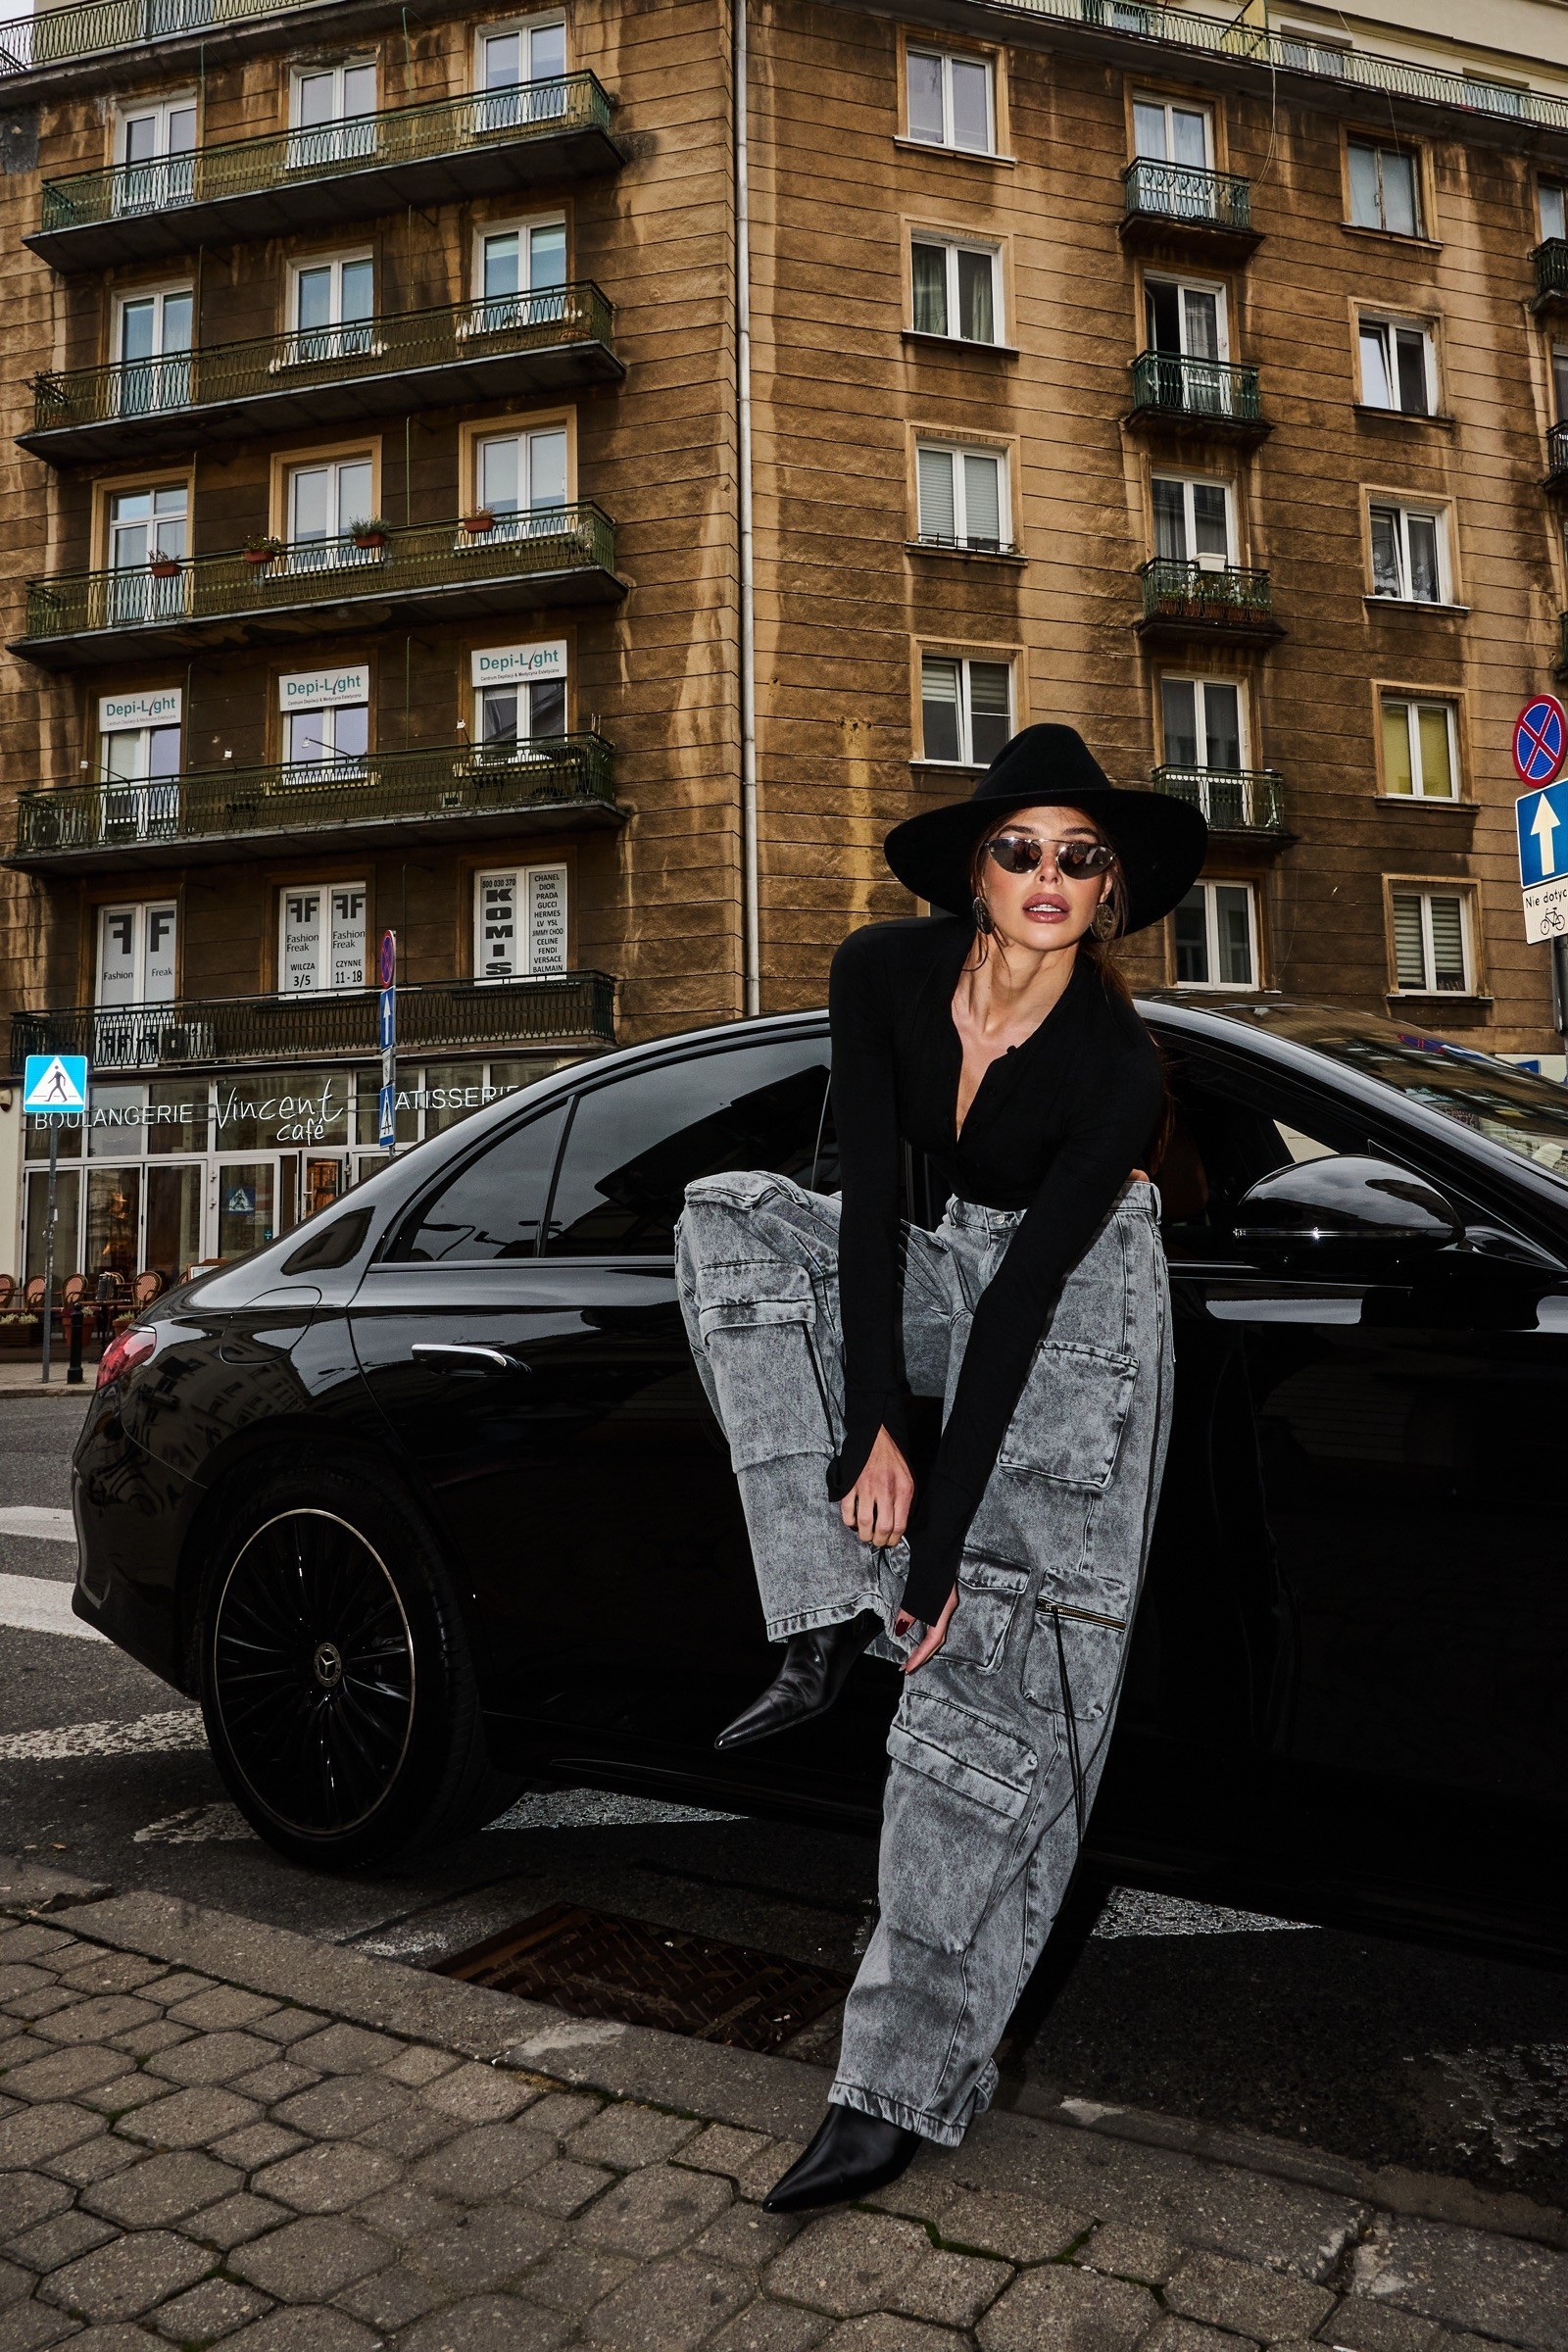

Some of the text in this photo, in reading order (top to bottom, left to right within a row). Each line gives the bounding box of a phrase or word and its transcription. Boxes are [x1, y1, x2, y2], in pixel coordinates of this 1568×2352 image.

[534, 873, 561, 882] CHANEL
[1525, 895, 1540, 908] Nie
[534, 909, 561, 918] HERMES
[333, 930, 366, 940] Fashion
[486, 888, 514, 976] KOMIS
[287, 934, 319, 943] Fashion
[536, 937, 559, 946] CELINE
[287, 943, 310, 953] Freak
[333, 940, 356, 949] Freak
[290, 962, 316, 971] WILCZA
[532, 964, 564, 973] BALMAIN
[104, 971, 133, 981] Fashion
[151, 967, 172, 977] Freak
[335, 971, 345, 984] 11
[352, 970, 363, 983] 18
[293, 974, 311, 988] 3/5
[215, 1078, 344, 1130] Vincent
[35, 1103, 194, 1130] BOULANGERIE
[276, 1117, 325, 1147] café
